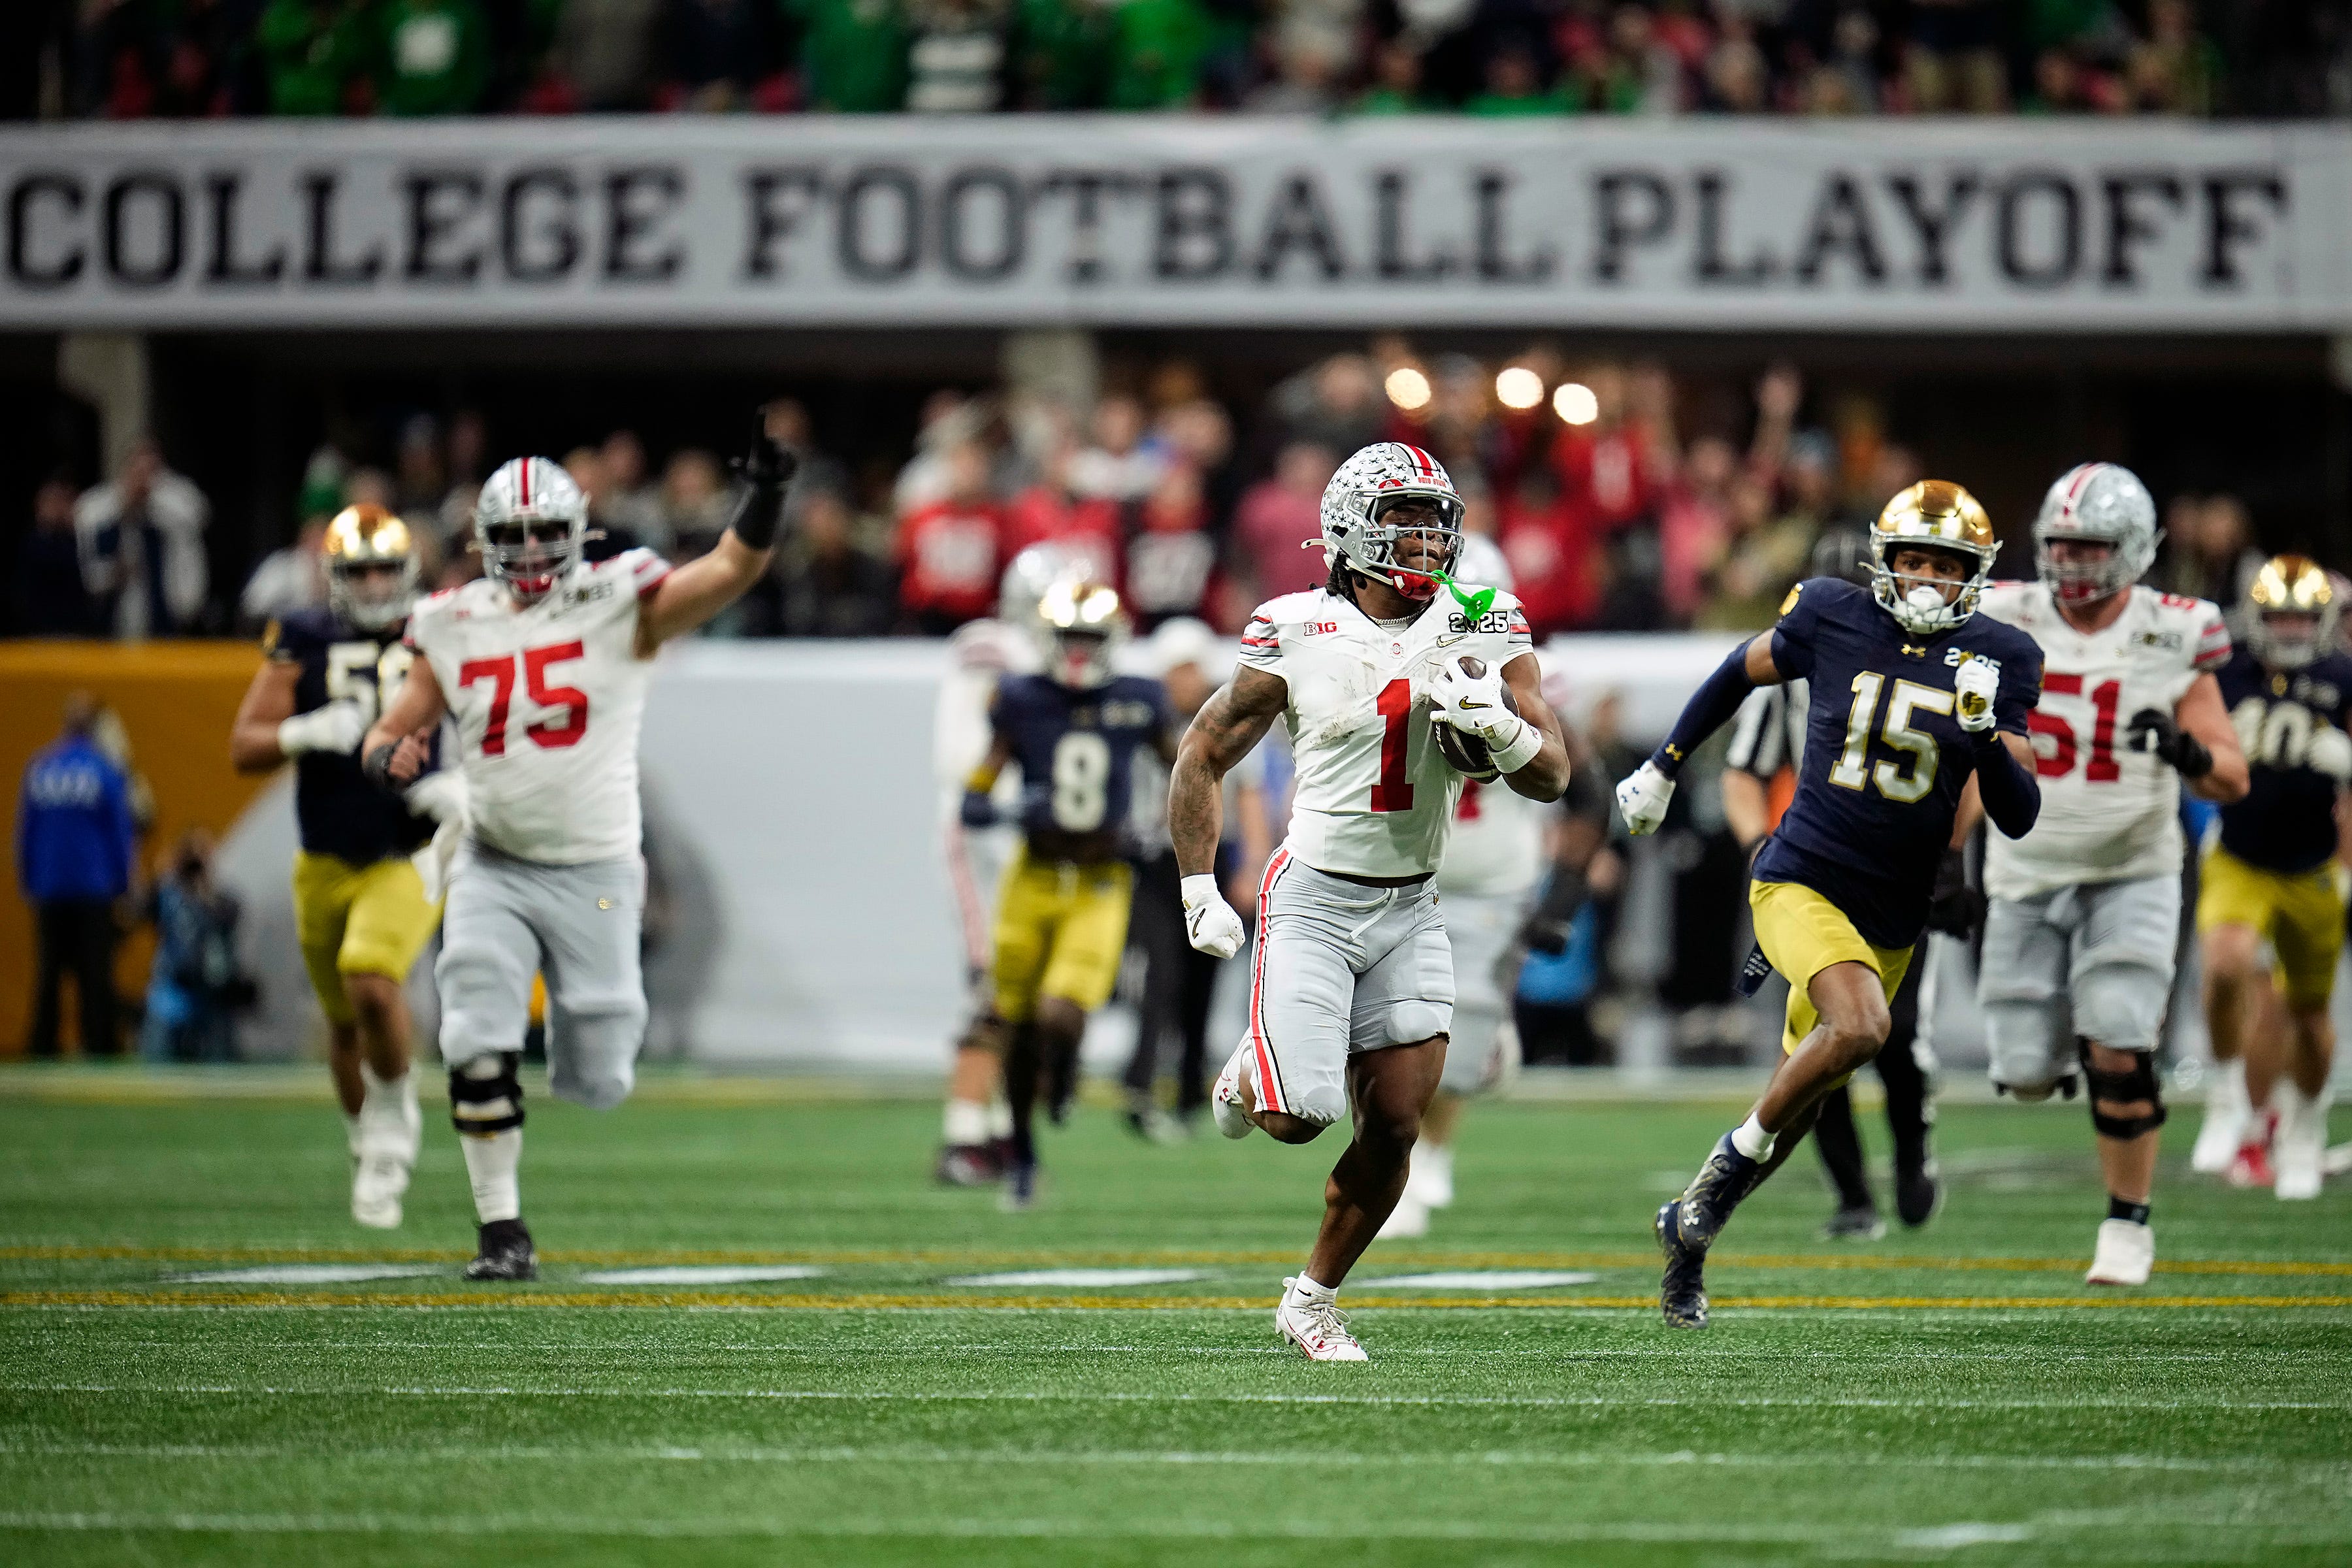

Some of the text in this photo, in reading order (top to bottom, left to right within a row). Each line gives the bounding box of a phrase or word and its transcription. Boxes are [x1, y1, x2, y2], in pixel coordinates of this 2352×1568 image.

[5, 163, 2288, 293] COLLEGE FOOTBALL PLAYOFF
[459, 638, 588, 759] 75
[1370, 678, 1414, 812] 1
[1828, 670, 1957, 804] 15
[2027, 670, 2121, 783] 51
[1051, 730, 1111, 832] 8
